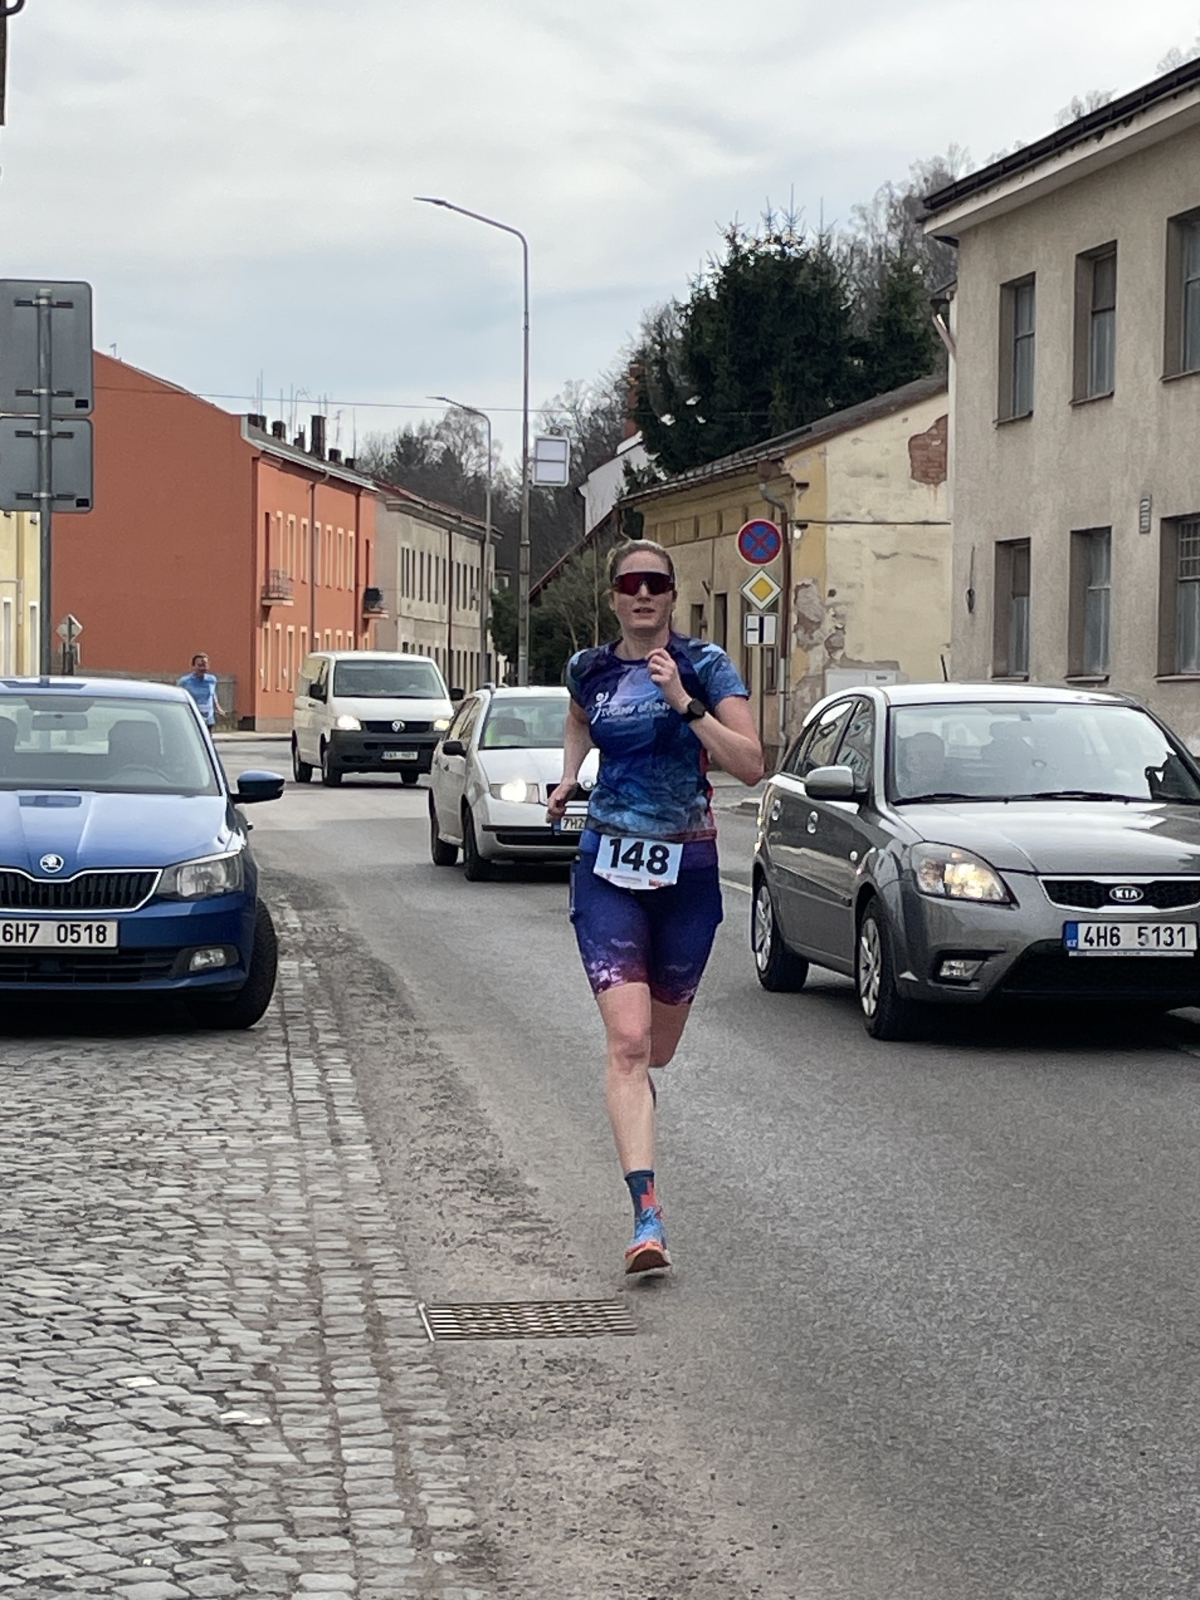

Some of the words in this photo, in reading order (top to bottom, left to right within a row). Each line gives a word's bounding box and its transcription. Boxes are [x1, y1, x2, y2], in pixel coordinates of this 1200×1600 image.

[609, 838, 670, 876] 148
[1115, 889, 1138, 899] KIA
[2, 922, 40, 943] 6H7
[56, 923, 108, 944] 0518
[1083, 926, 1121, 947] 4H6
[1137, 926, 1186, 948] 5131
